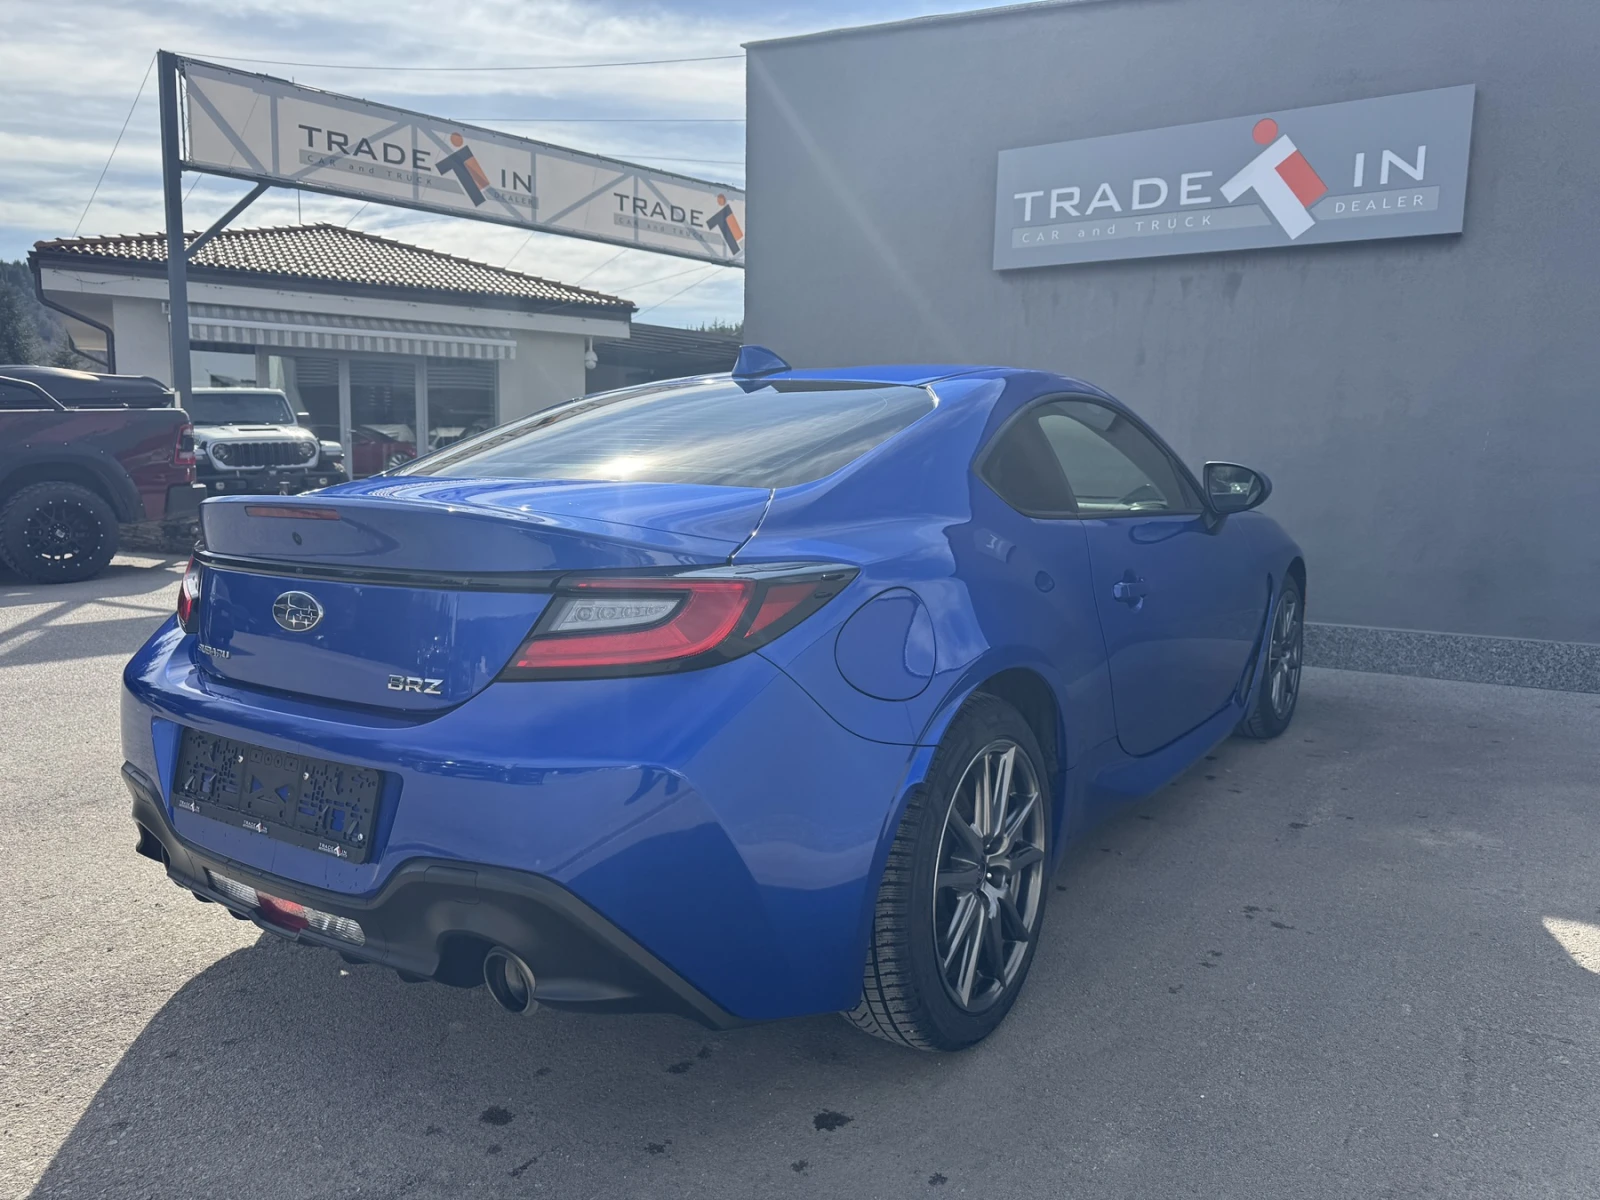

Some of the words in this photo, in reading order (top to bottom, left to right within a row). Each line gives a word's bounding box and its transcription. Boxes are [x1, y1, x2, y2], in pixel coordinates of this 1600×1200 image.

[298, 124, 431, 172] TRADE
[501, 169, 532, 194] IN
[307, 154, 336, 168] CAR
[348, 164, 375, 174] and
[387, 170, 432, 186] TRUCK
[1013, 170, 1213, 222] TRADE
[1353, 145, 1427, 188] IN
[613, 192, 704, 228] TRADE
[1335, 194, 1424, 213] DEALER
[1022, 229, 1060, 244] CAR
[1077, 224, 1116, 238] and
[1135, 215, 1212, 232] TRUCK
[388, 674, 444, 695] BRZ
